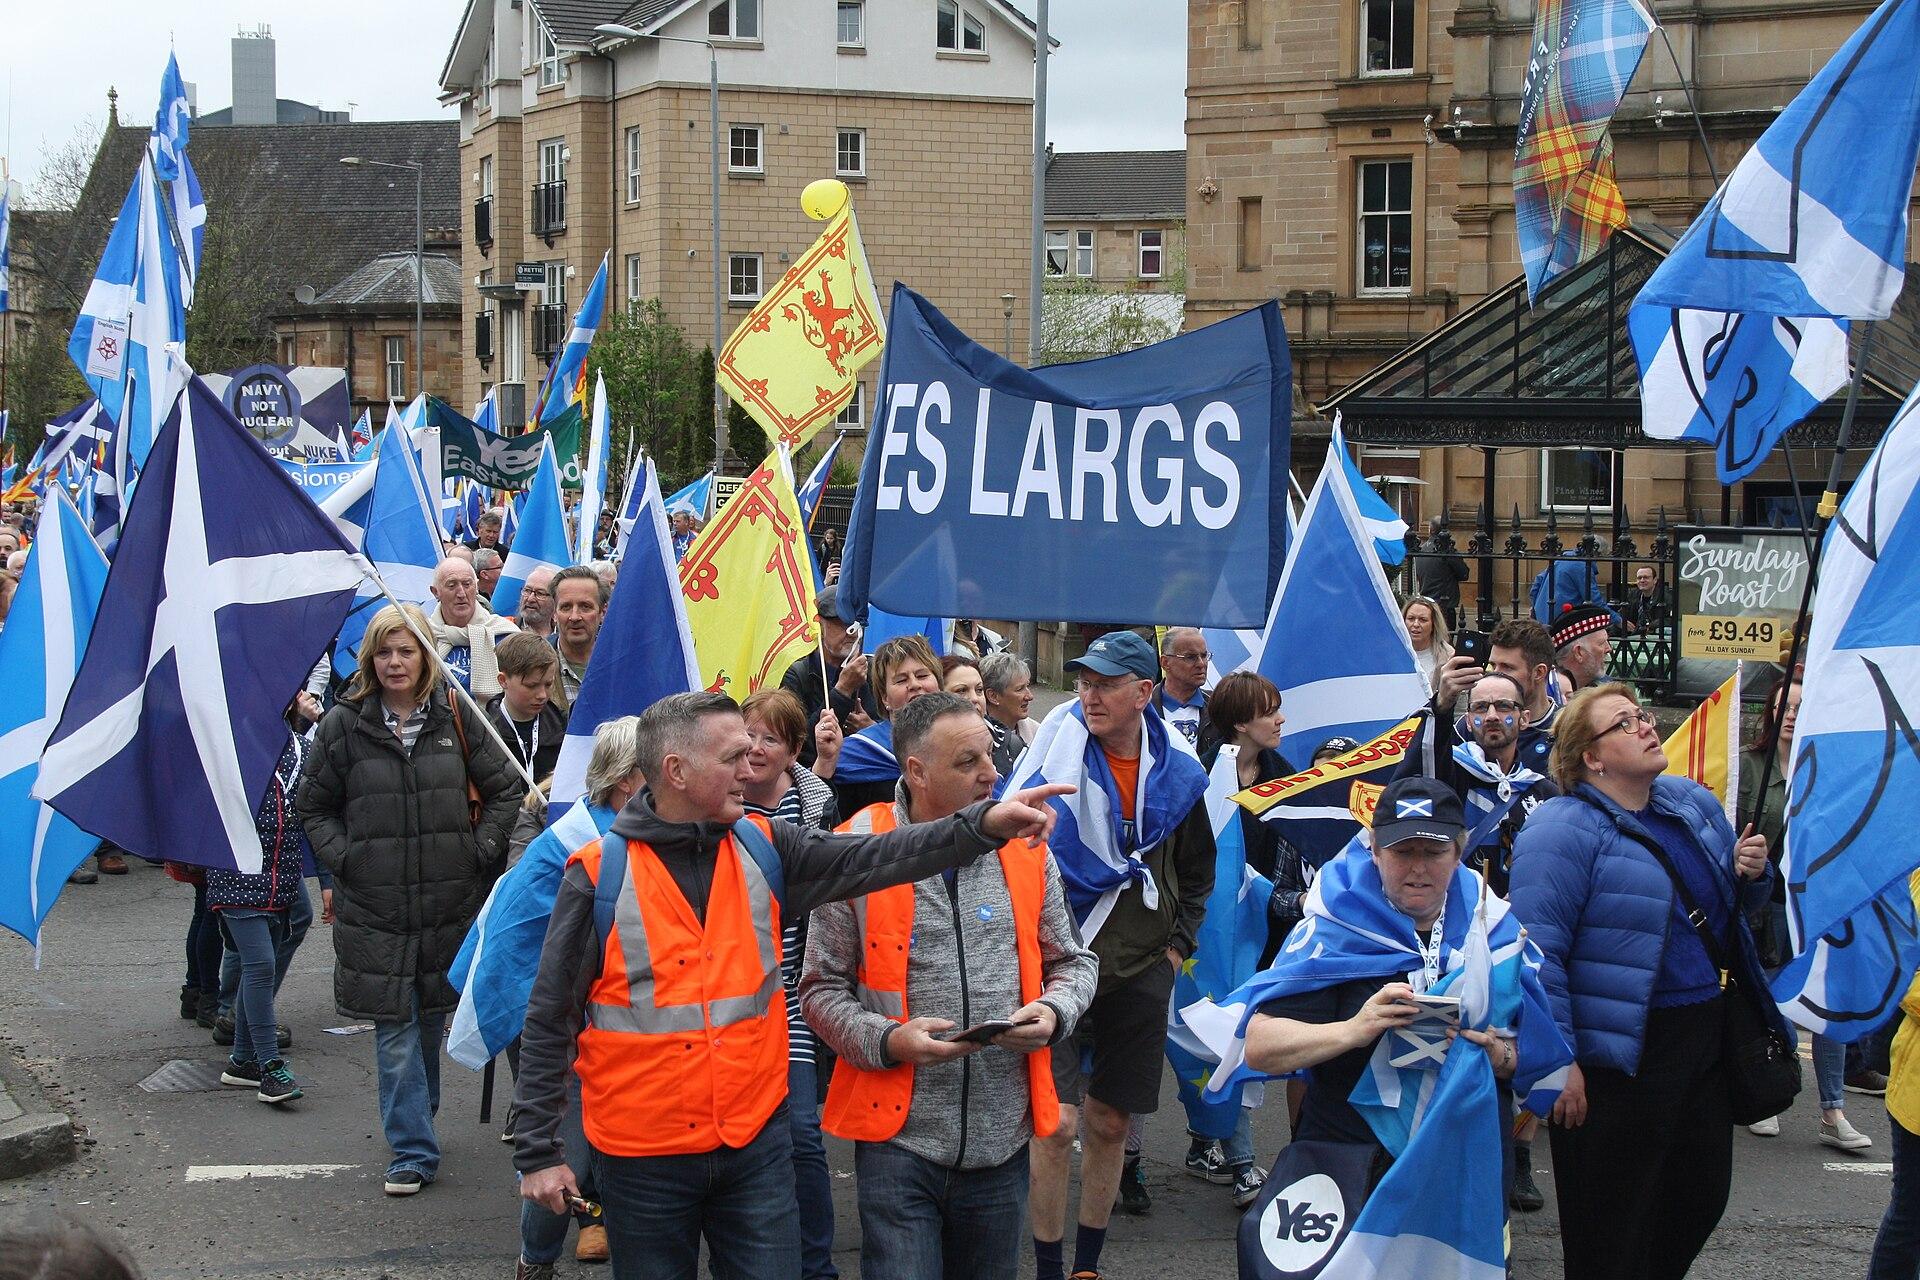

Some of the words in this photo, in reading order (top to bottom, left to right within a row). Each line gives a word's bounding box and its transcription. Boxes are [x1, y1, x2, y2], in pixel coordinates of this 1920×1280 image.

[241, 384, 283, 397] NAVY
[251, 401, 278, 412] NOT
[264, 445, 290, 456] out
[443, 444, 581, 490] Eastwd
[876, 380, 951, 515] ES
[969, 388, 1241, 530] LARGS
[1681, 534, 1808, 593] Sunday
[1699, 567, 1777, 612] Roast
[1688, 627, 1706, 637] from
[1709, 620, 1773, 643] £9.49
[1275, 1198, 1338, 1243] Yes
